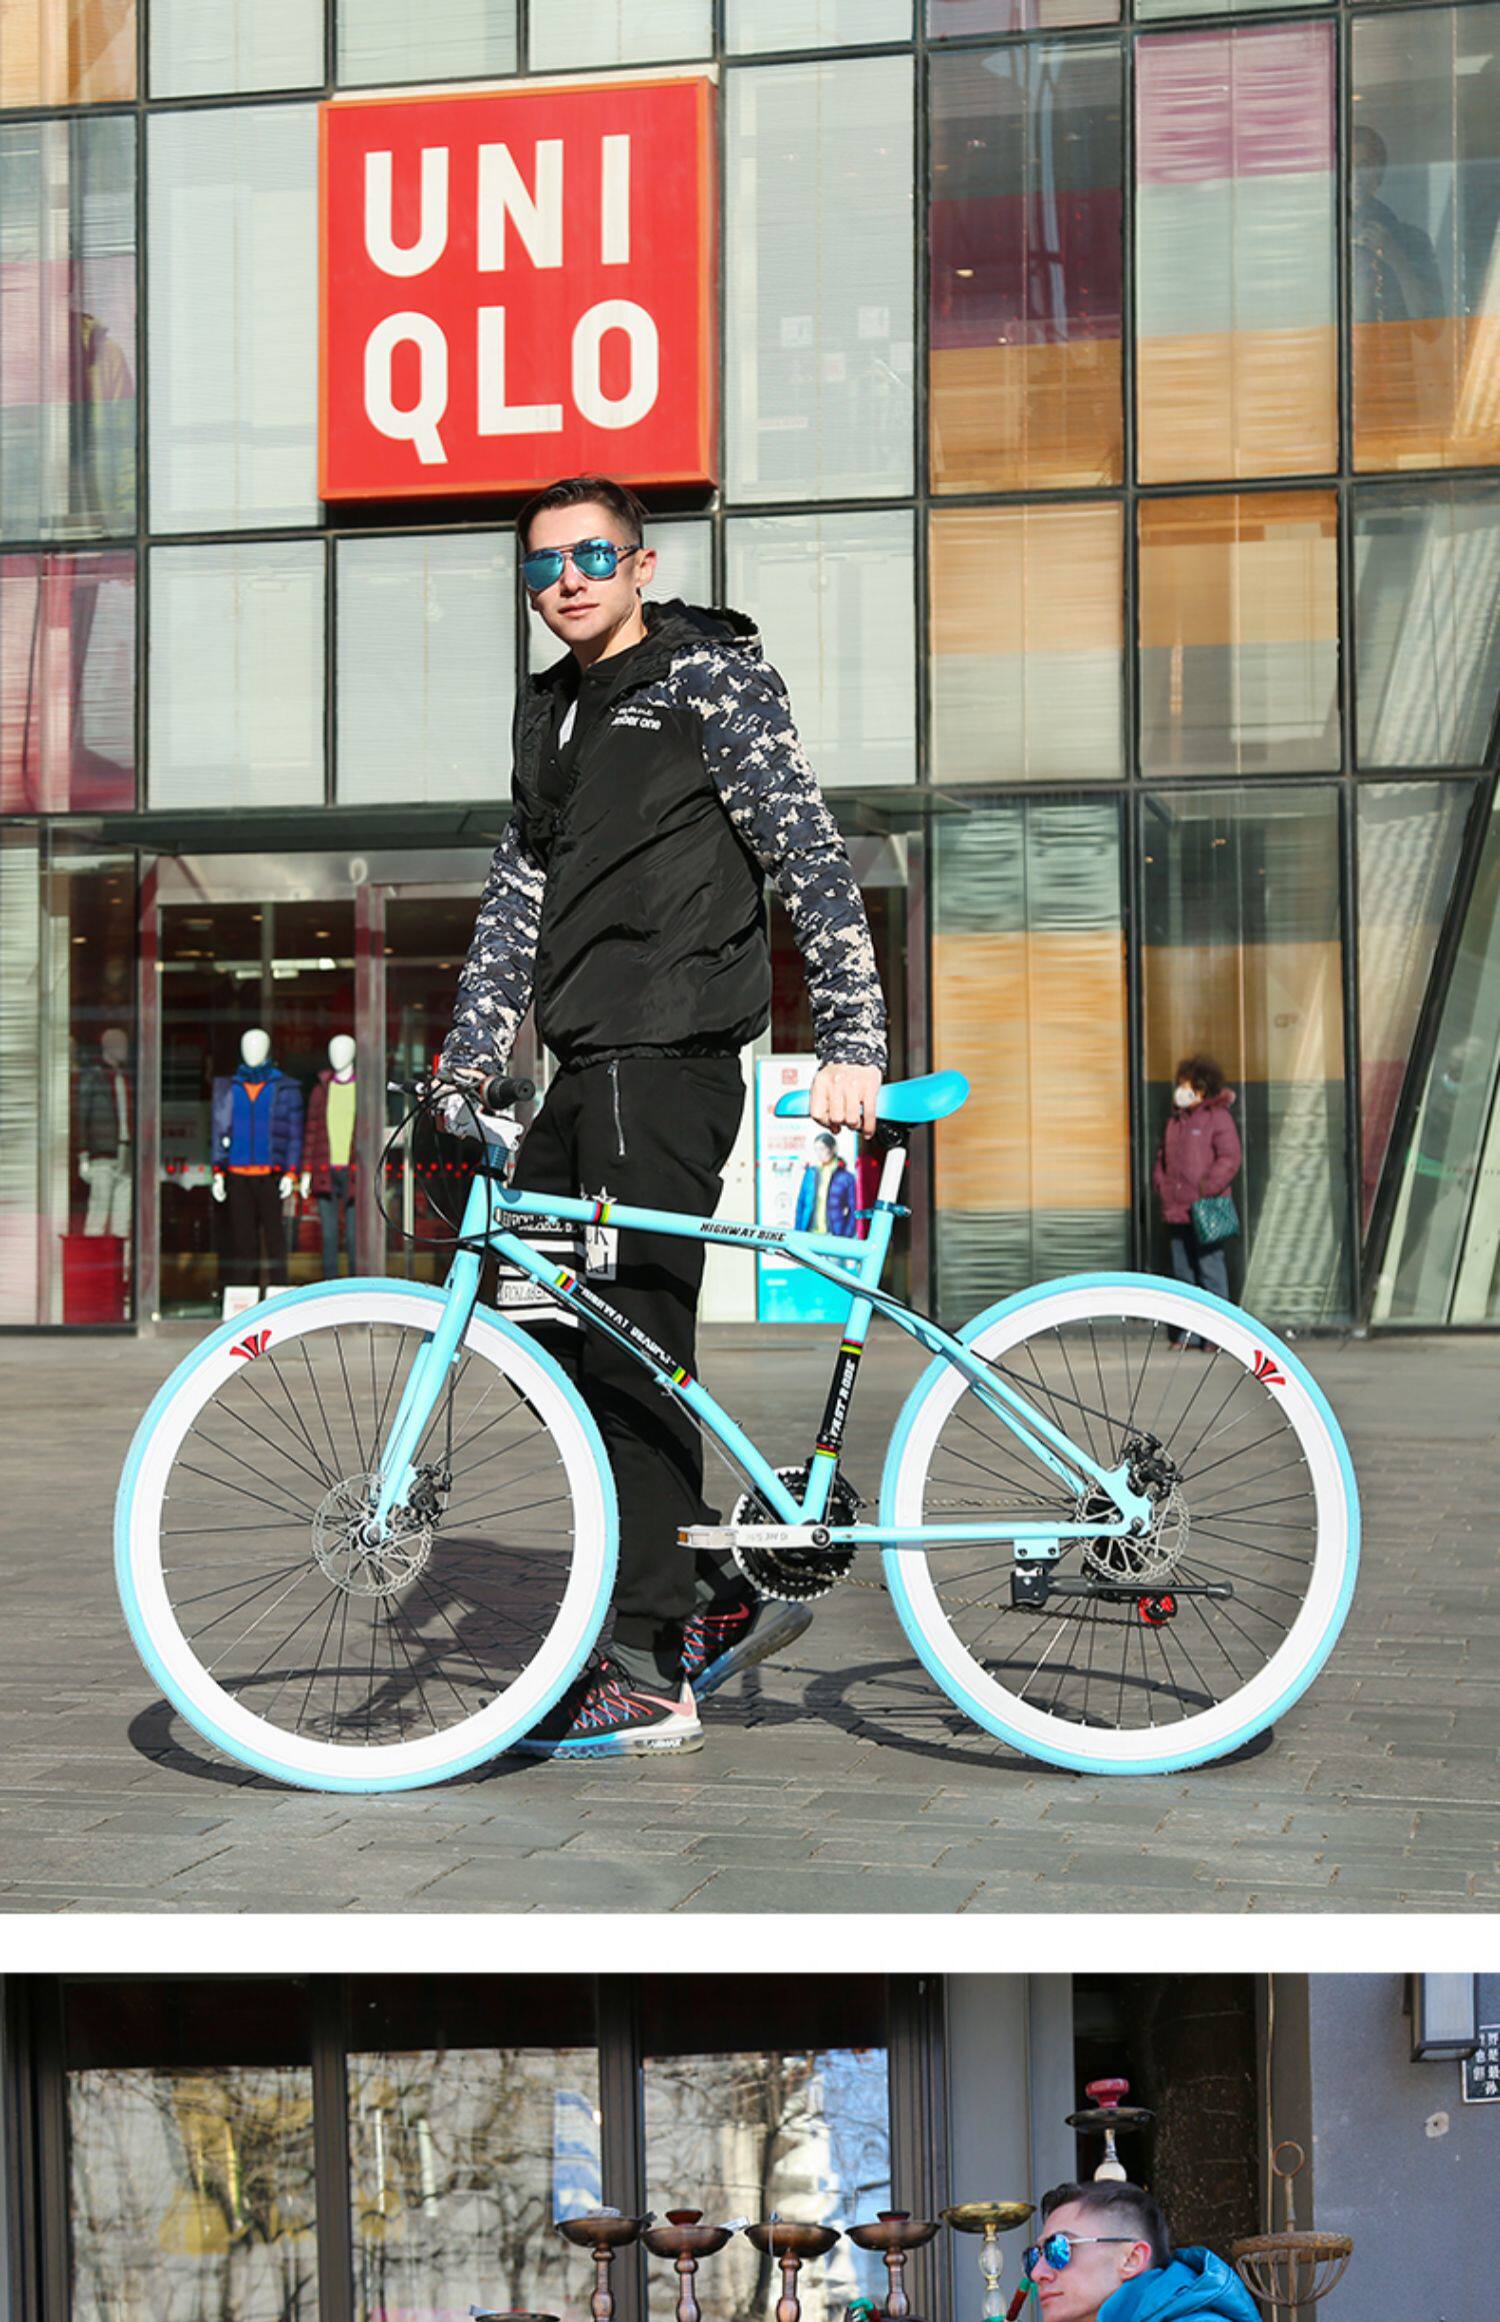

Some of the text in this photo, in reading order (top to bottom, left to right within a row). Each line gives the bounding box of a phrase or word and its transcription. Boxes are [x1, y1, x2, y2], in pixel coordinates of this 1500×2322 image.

[365, 134, 631, 278] UNI
[364, 299, 659, 464] QLO
[700, 1222, 787, 1242] HIGHWAY BIKE
